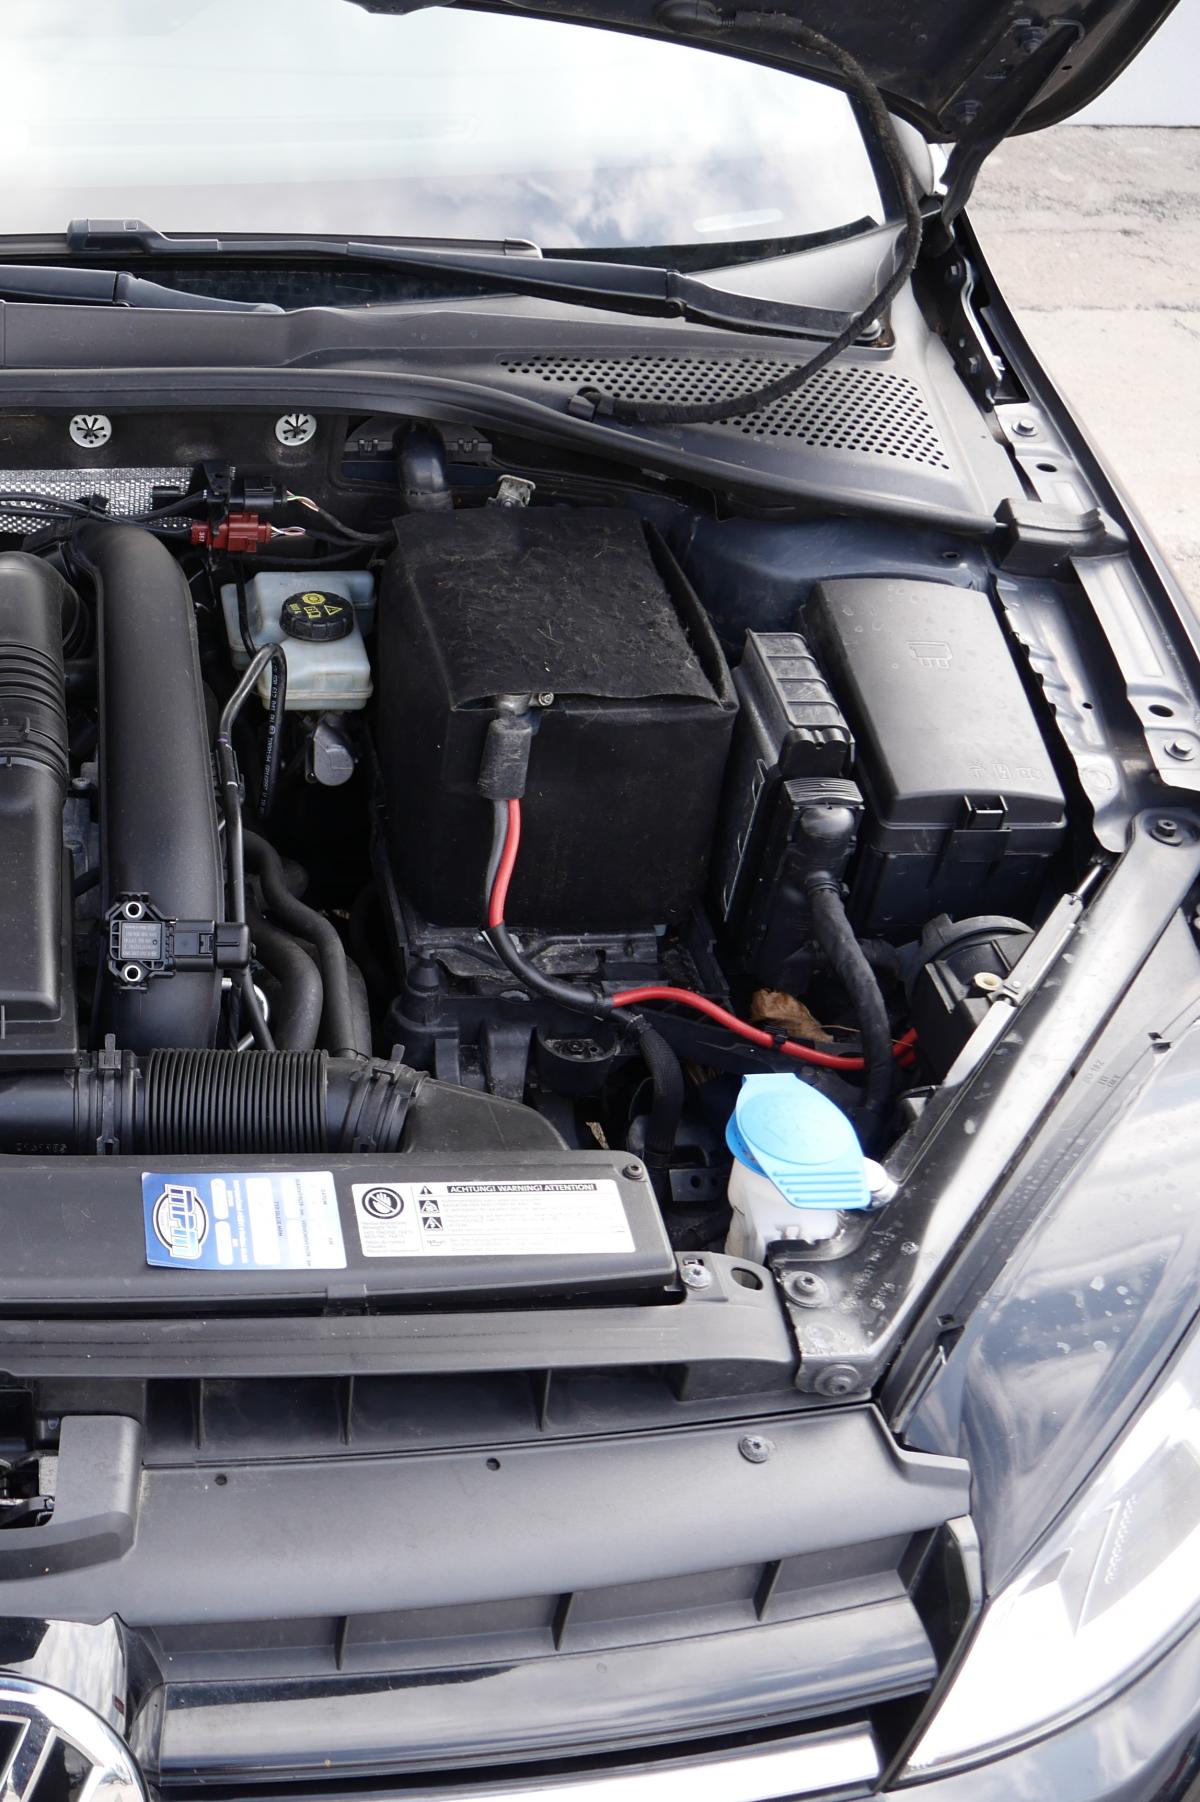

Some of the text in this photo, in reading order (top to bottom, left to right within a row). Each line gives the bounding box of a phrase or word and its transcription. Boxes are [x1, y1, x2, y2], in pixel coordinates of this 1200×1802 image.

[450, 1183, 595, 1193] ACHTUNG! WARNING! ATTENTION!
